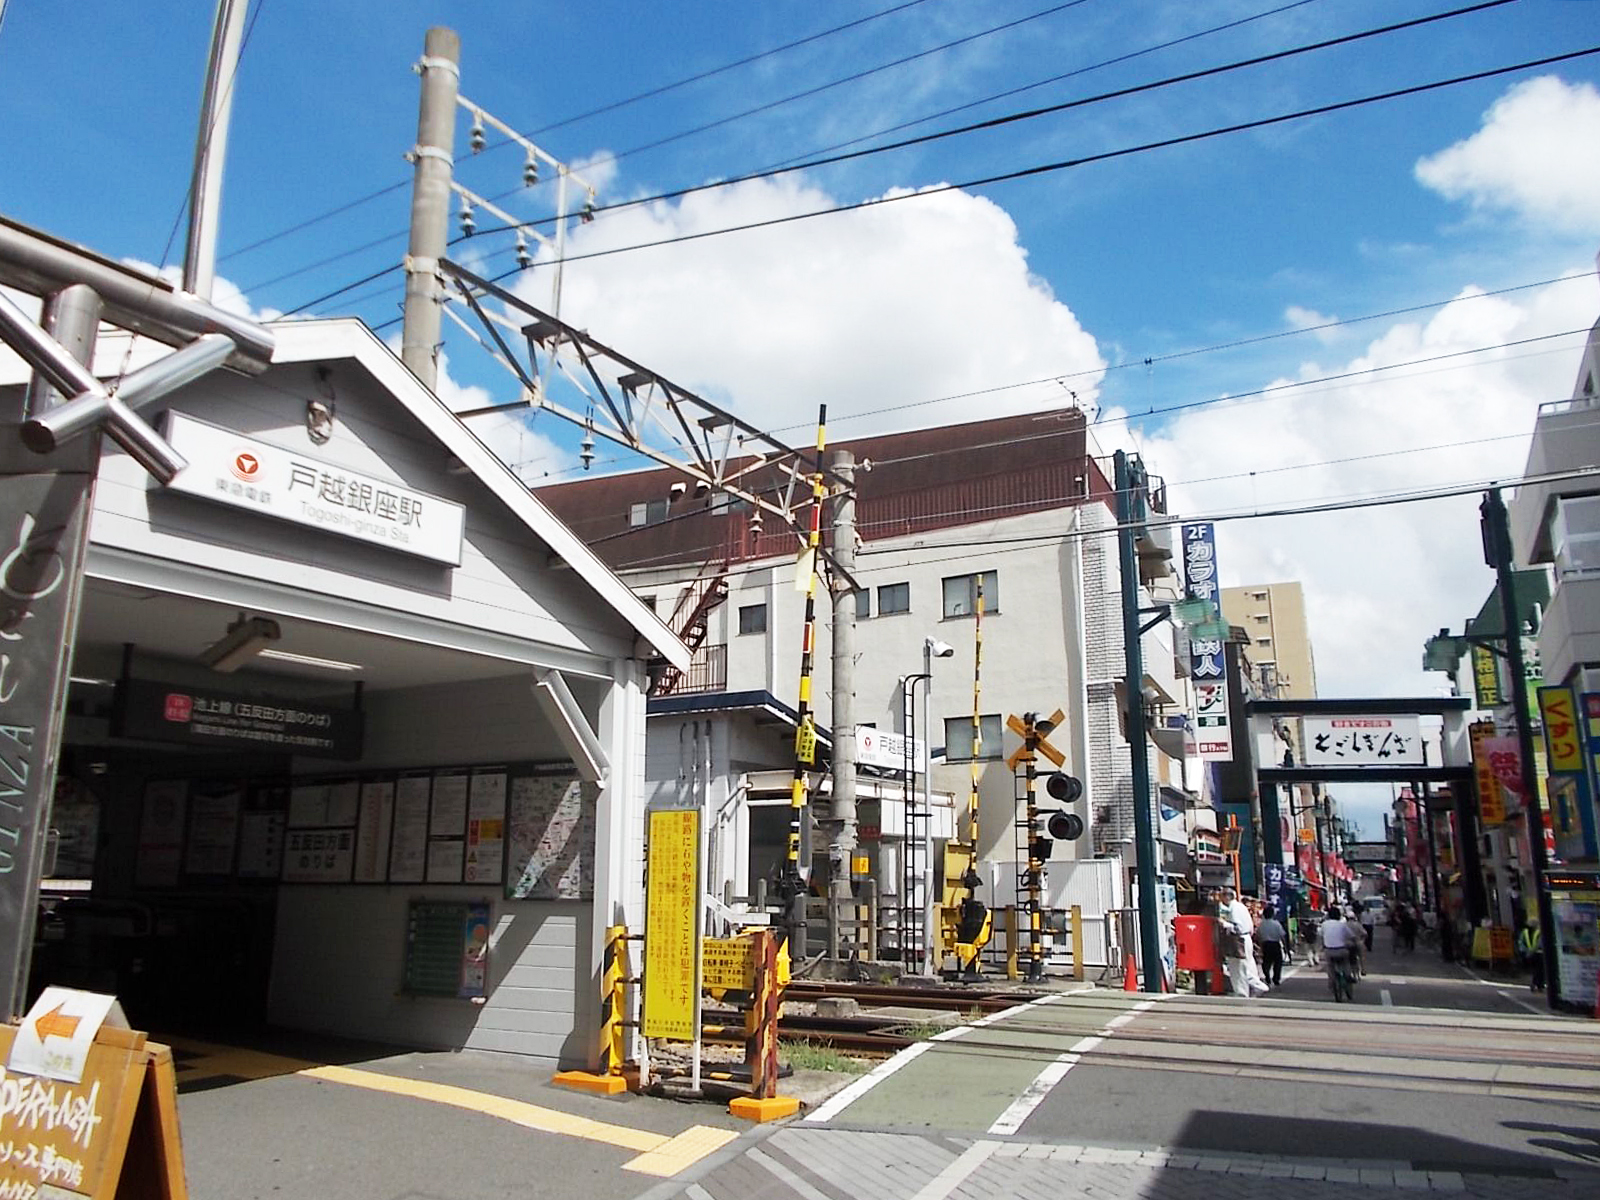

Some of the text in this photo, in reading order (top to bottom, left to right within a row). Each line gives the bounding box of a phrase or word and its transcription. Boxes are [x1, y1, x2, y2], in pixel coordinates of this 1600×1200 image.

[287, 461, 423, 528] 戸越銀座駅
[300, 500, 387, 538] Togoshi-ginza
[1188, 525, 1208, 540] 2F
[1315, 732, 1411, 757] とごしぎんざ
[289, 833, 350, 851] 五反田方面
